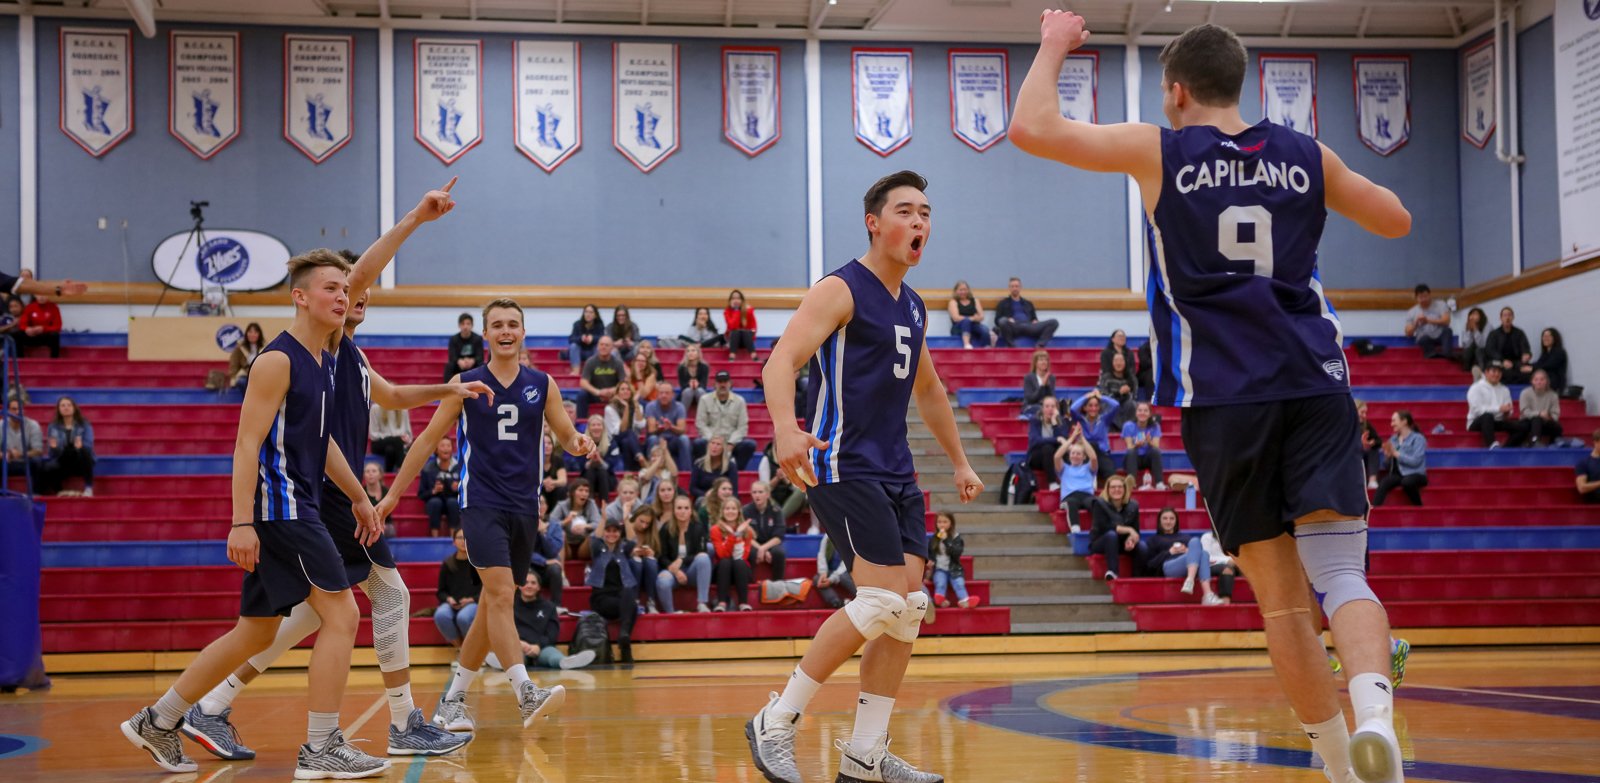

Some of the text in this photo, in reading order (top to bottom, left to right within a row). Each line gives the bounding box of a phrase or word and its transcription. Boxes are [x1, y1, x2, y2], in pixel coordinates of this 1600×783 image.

[71, 52, 118, 61] AGGREGATE
[180, 53, 228, 61] CHAMPIONS
[316, 66, 344, 74] SOCCER
[1175, 158, 1310, 194] CAPILANO
[1218, 204, 1274, 279] 9
[893, 324, 912, 380] 5
[320, 390, 326, 438] 1
[497, 404, 519, 441] 2
